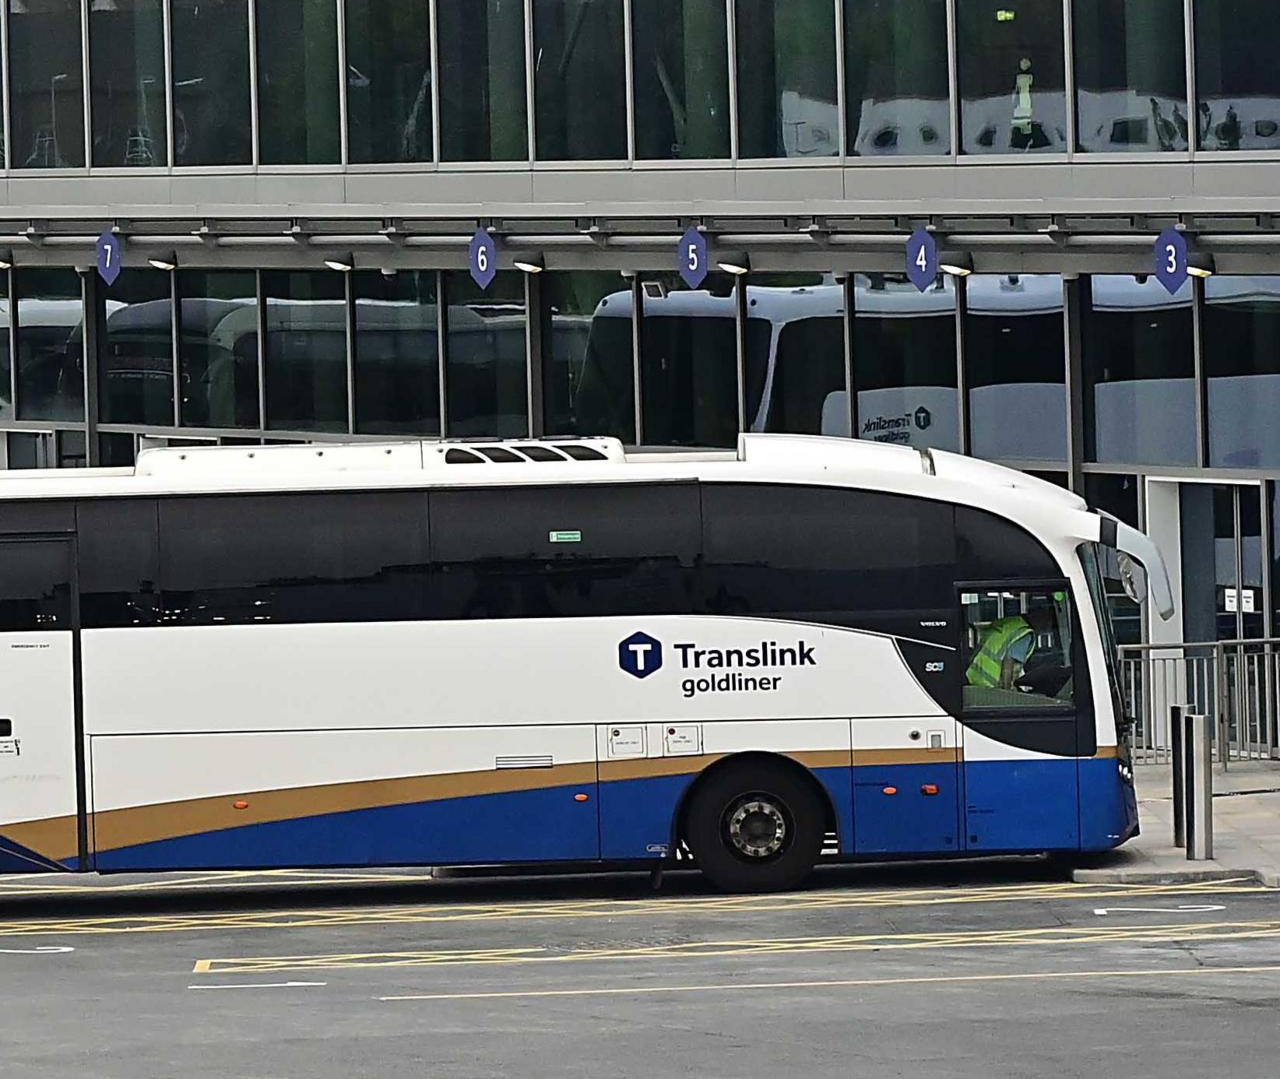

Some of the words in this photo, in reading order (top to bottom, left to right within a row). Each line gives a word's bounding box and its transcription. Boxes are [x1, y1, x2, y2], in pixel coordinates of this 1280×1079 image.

[103, 245, 112, 268] 7
[477, 246, 488, 272] 6
[688, 244, 698, 271] 5
[915, 245, 927, 272] 4
[1165, 244, 1177, 273] 3
[673, 640, 817, 669] Translink
[682, 673, 782, 698] goldliner
